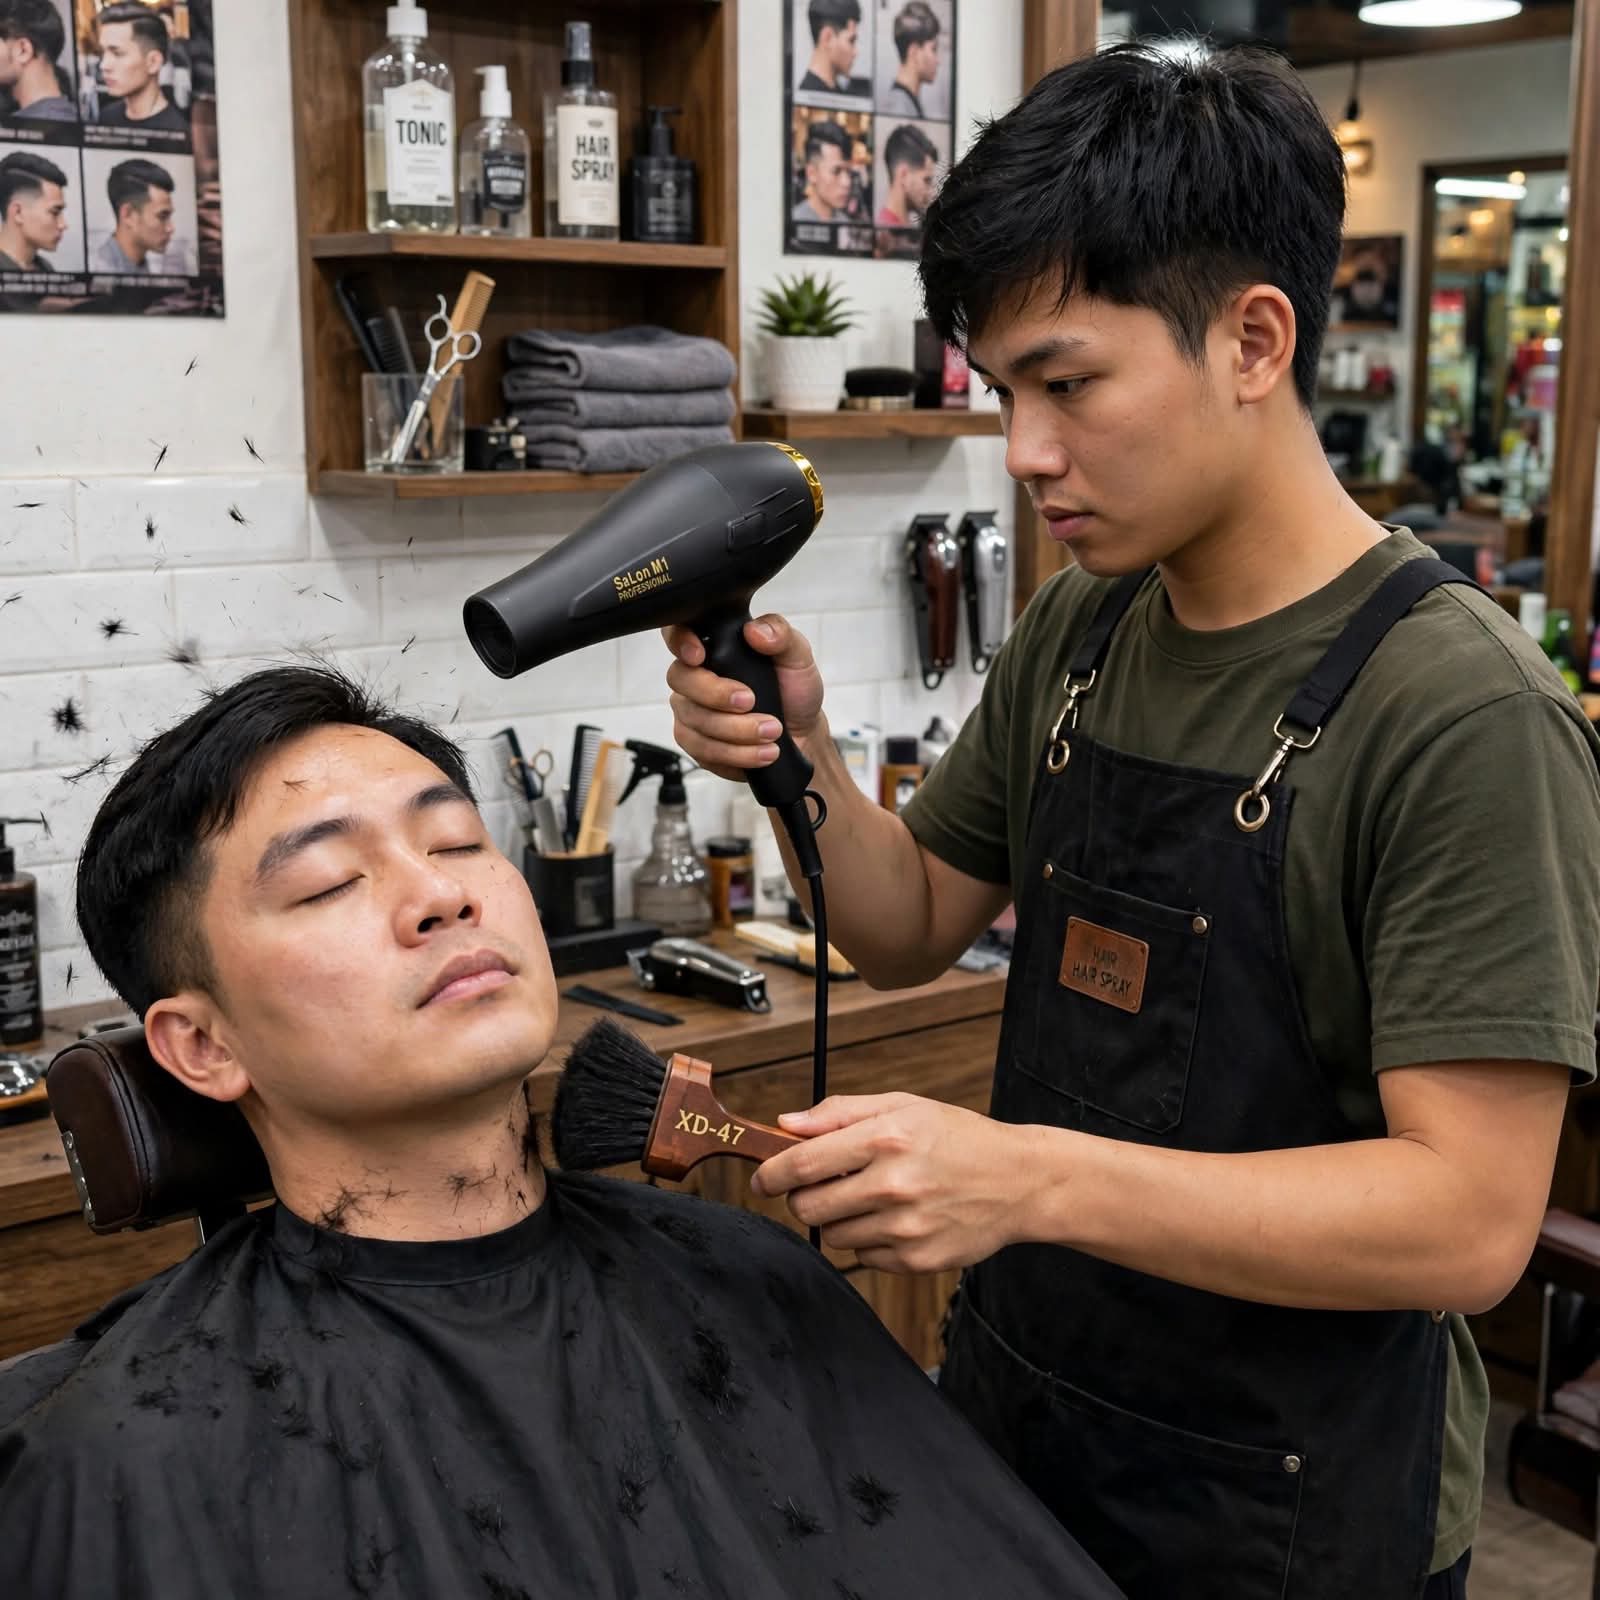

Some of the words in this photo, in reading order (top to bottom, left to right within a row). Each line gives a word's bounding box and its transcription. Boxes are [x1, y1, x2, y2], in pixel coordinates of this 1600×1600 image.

[395, 119, 447, 146] TONIC
[576, 135, 610, 156] HAIR
[571, 159, 614, 181] SPRAY
[613, 567, 651, 591] SaLon
[651, 556, 669, 574] M1
[1100, 971, 1132, 997] SPRAY
[674, 1108, 746, 1146] XD-47
